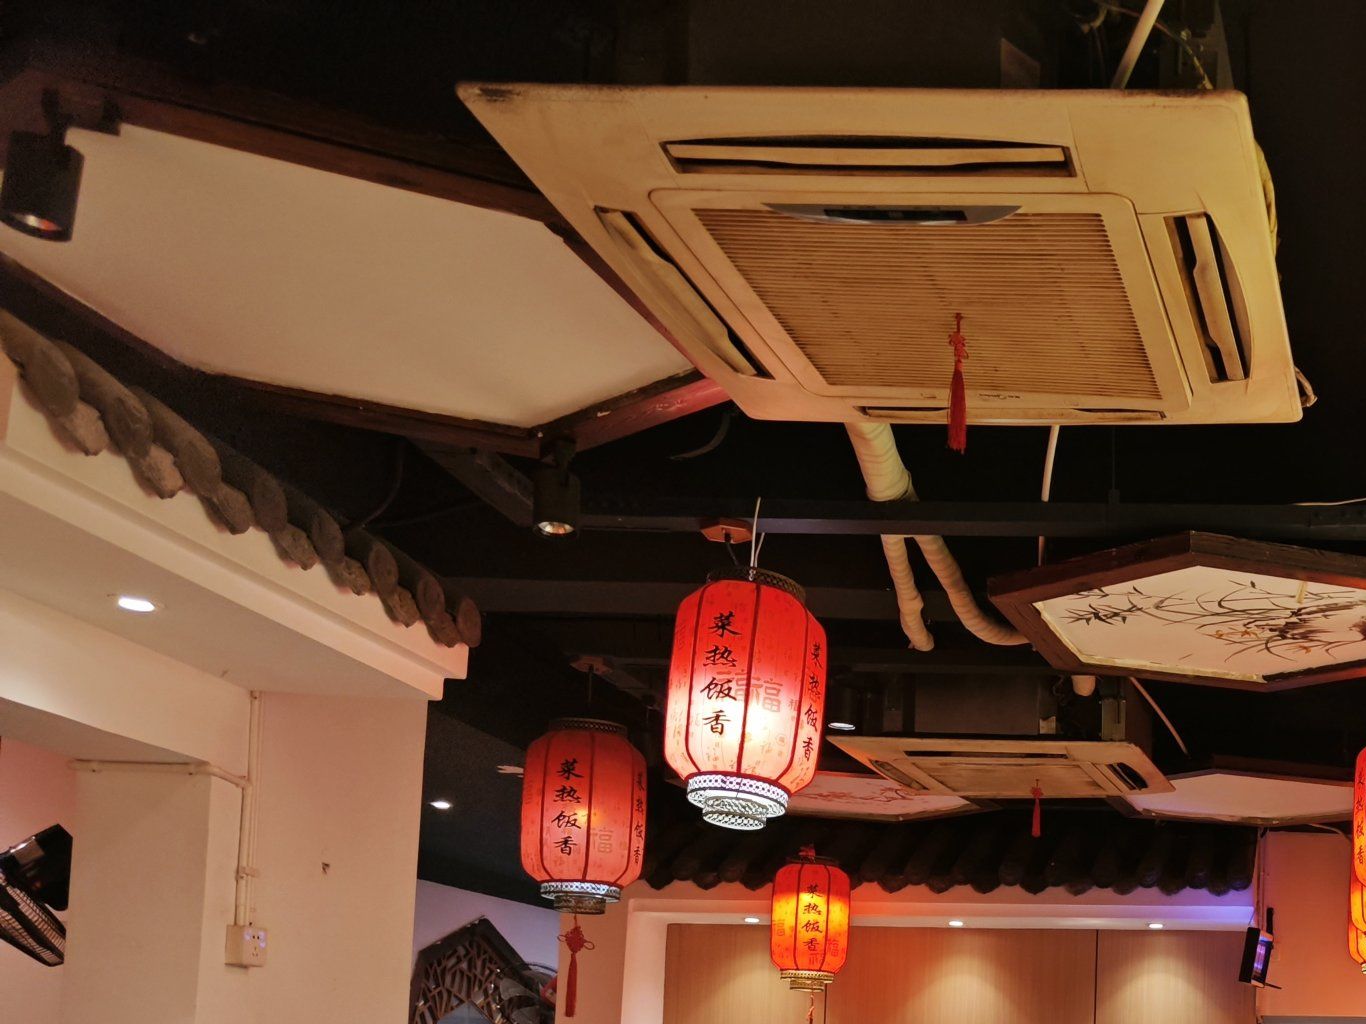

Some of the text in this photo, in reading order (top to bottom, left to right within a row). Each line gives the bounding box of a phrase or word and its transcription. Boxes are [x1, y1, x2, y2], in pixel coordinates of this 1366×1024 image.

[700, 611, 742, 736] 菜热饭香
[551, 758, 584, 857] 菜热饭香
[801, 883, 824, 952] 菜热饭香
